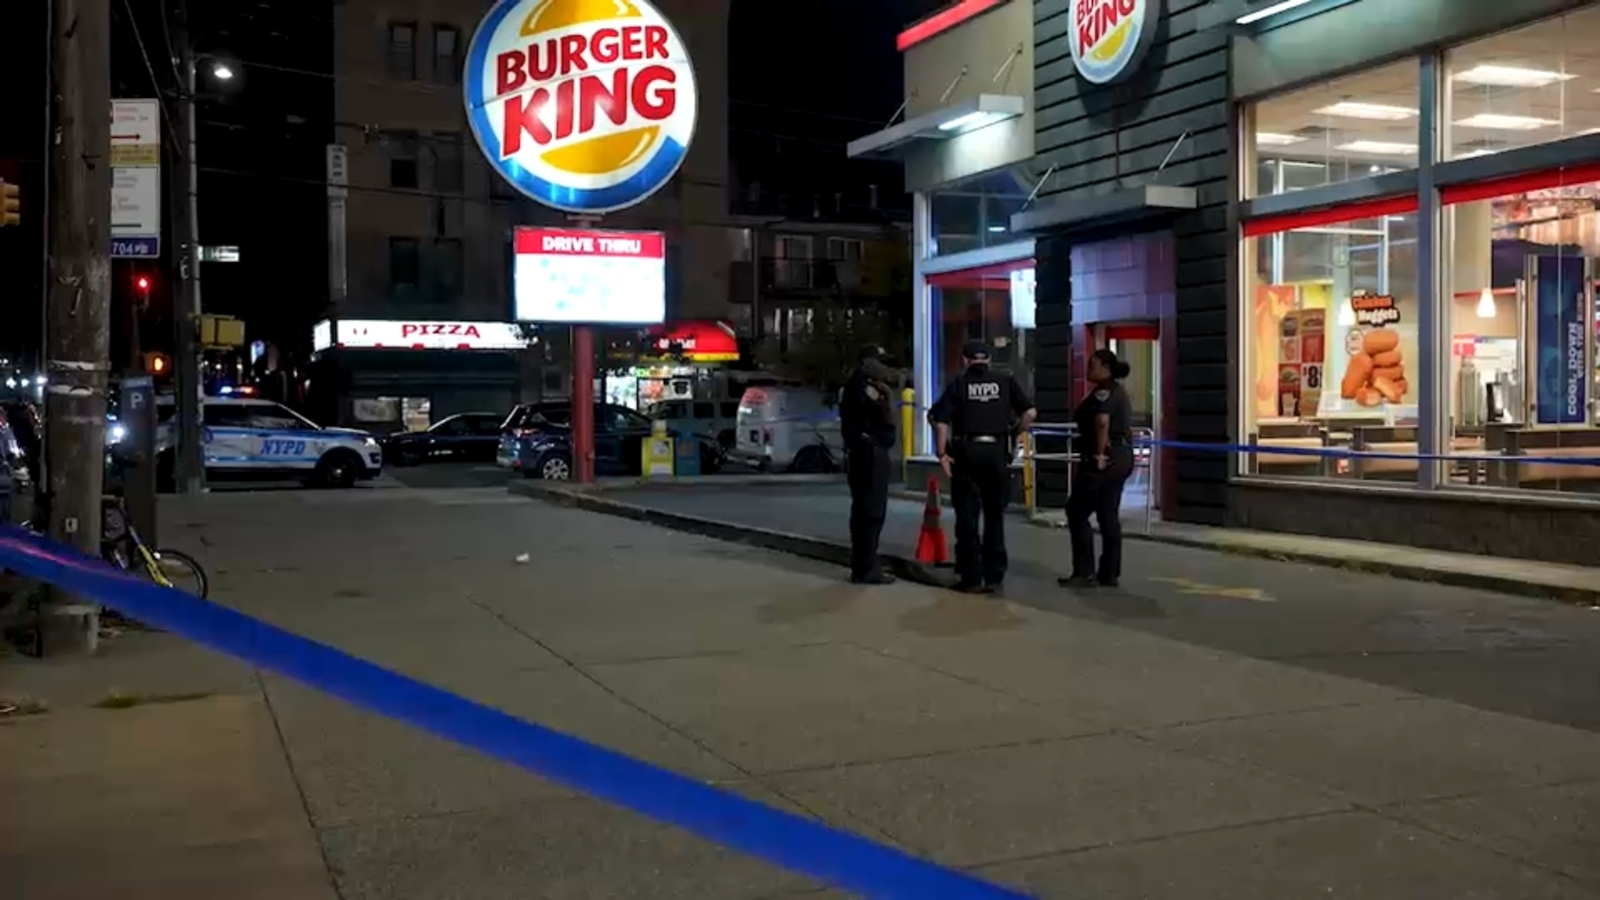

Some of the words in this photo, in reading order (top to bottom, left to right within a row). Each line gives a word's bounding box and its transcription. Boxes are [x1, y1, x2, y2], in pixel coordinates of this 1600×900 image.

[497, 25, 669, 95] BURGER
[503, 65, 677, 158] KING
[542, 236, 594, 252] DRIVE
[598, 238, 641, 254] THRU
[1358, 307, 1398, 324] Nuggets
[402, 324, 481, 339] PIZZA
[1568, 322, 1577, 370] DOWN
[968, 382, 999, 396] NYPD
[1568, 373, 1577, 416] COOL
[130, 392, 143, 409] P
[260, 439, 307, 455] NYPD
